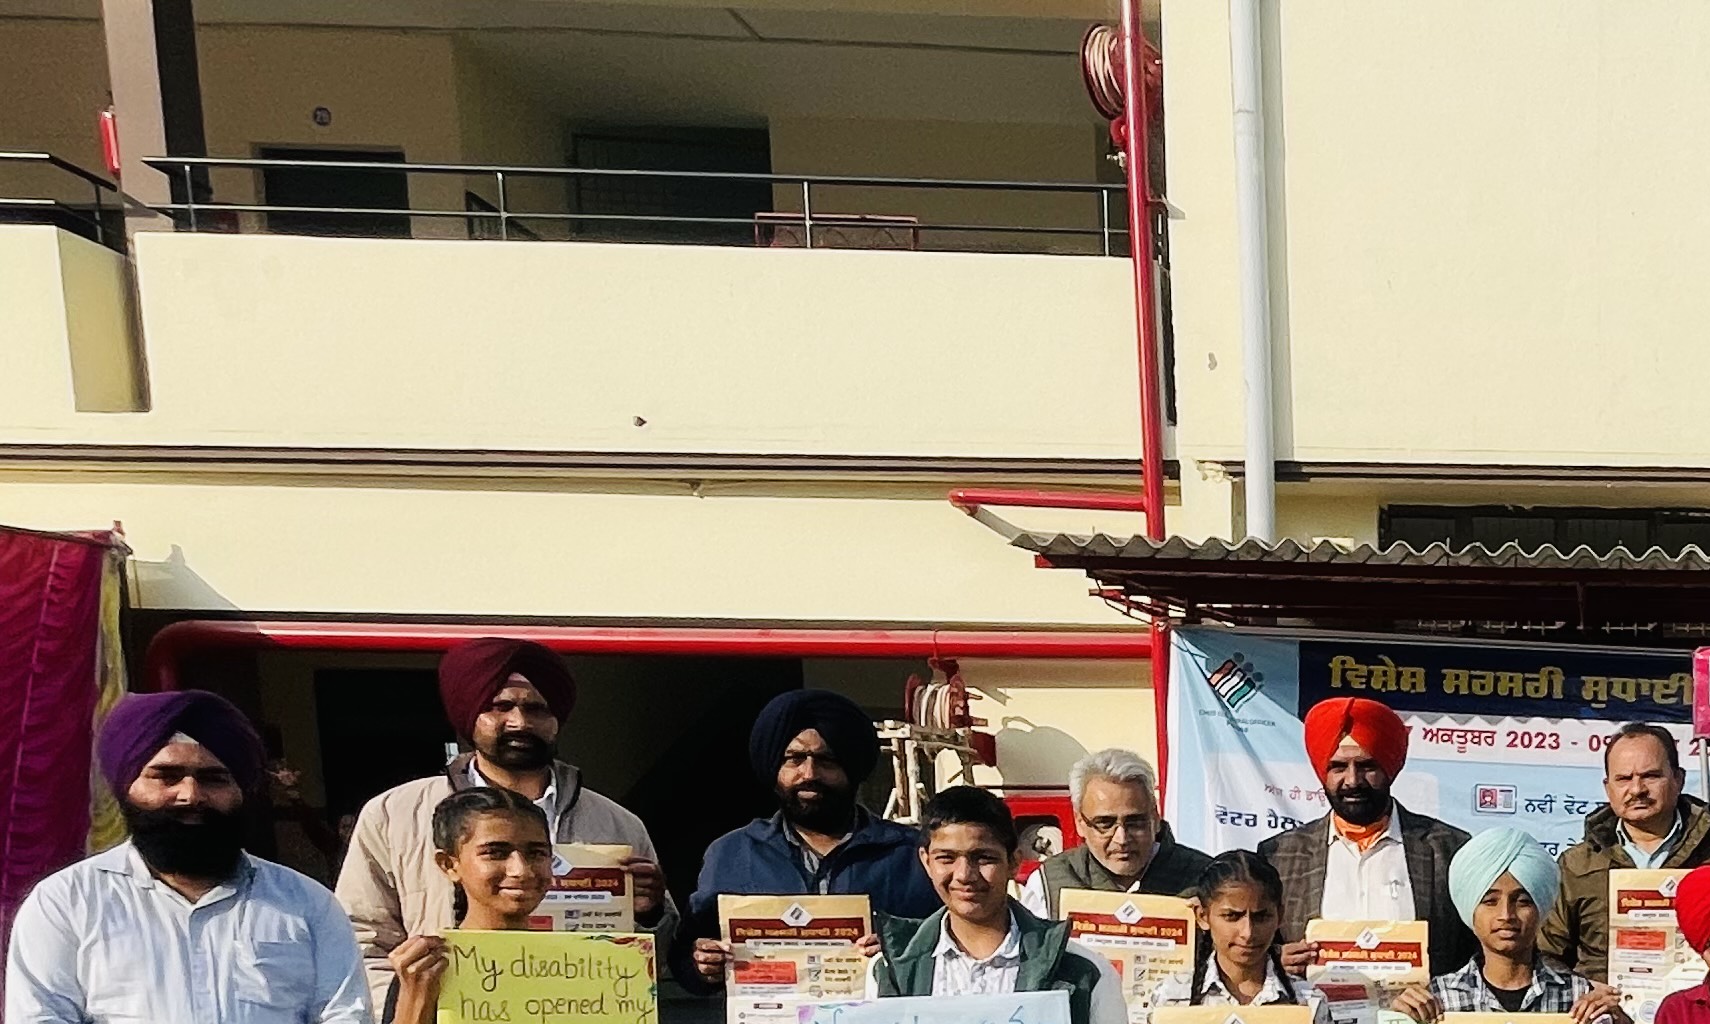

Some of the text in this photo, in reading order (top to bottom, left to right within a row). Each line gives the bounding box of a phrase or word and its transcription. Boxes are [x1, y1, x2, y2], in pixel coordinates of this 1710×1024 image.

[1441, 666, 1566, 700] ਸਰਸਰੀ
[1422, 725, 1497, 753] ਅਕਤੂਬਰ
[1506, 731, 1561, 750] 2023
[1524, 794, 1558, 815] ਨਵੀਂ
[1564, 795, 1589, 815] ਵੋਟ
[453, 944, 640, 998] My disability
[458, 990, 511, 1022] has
